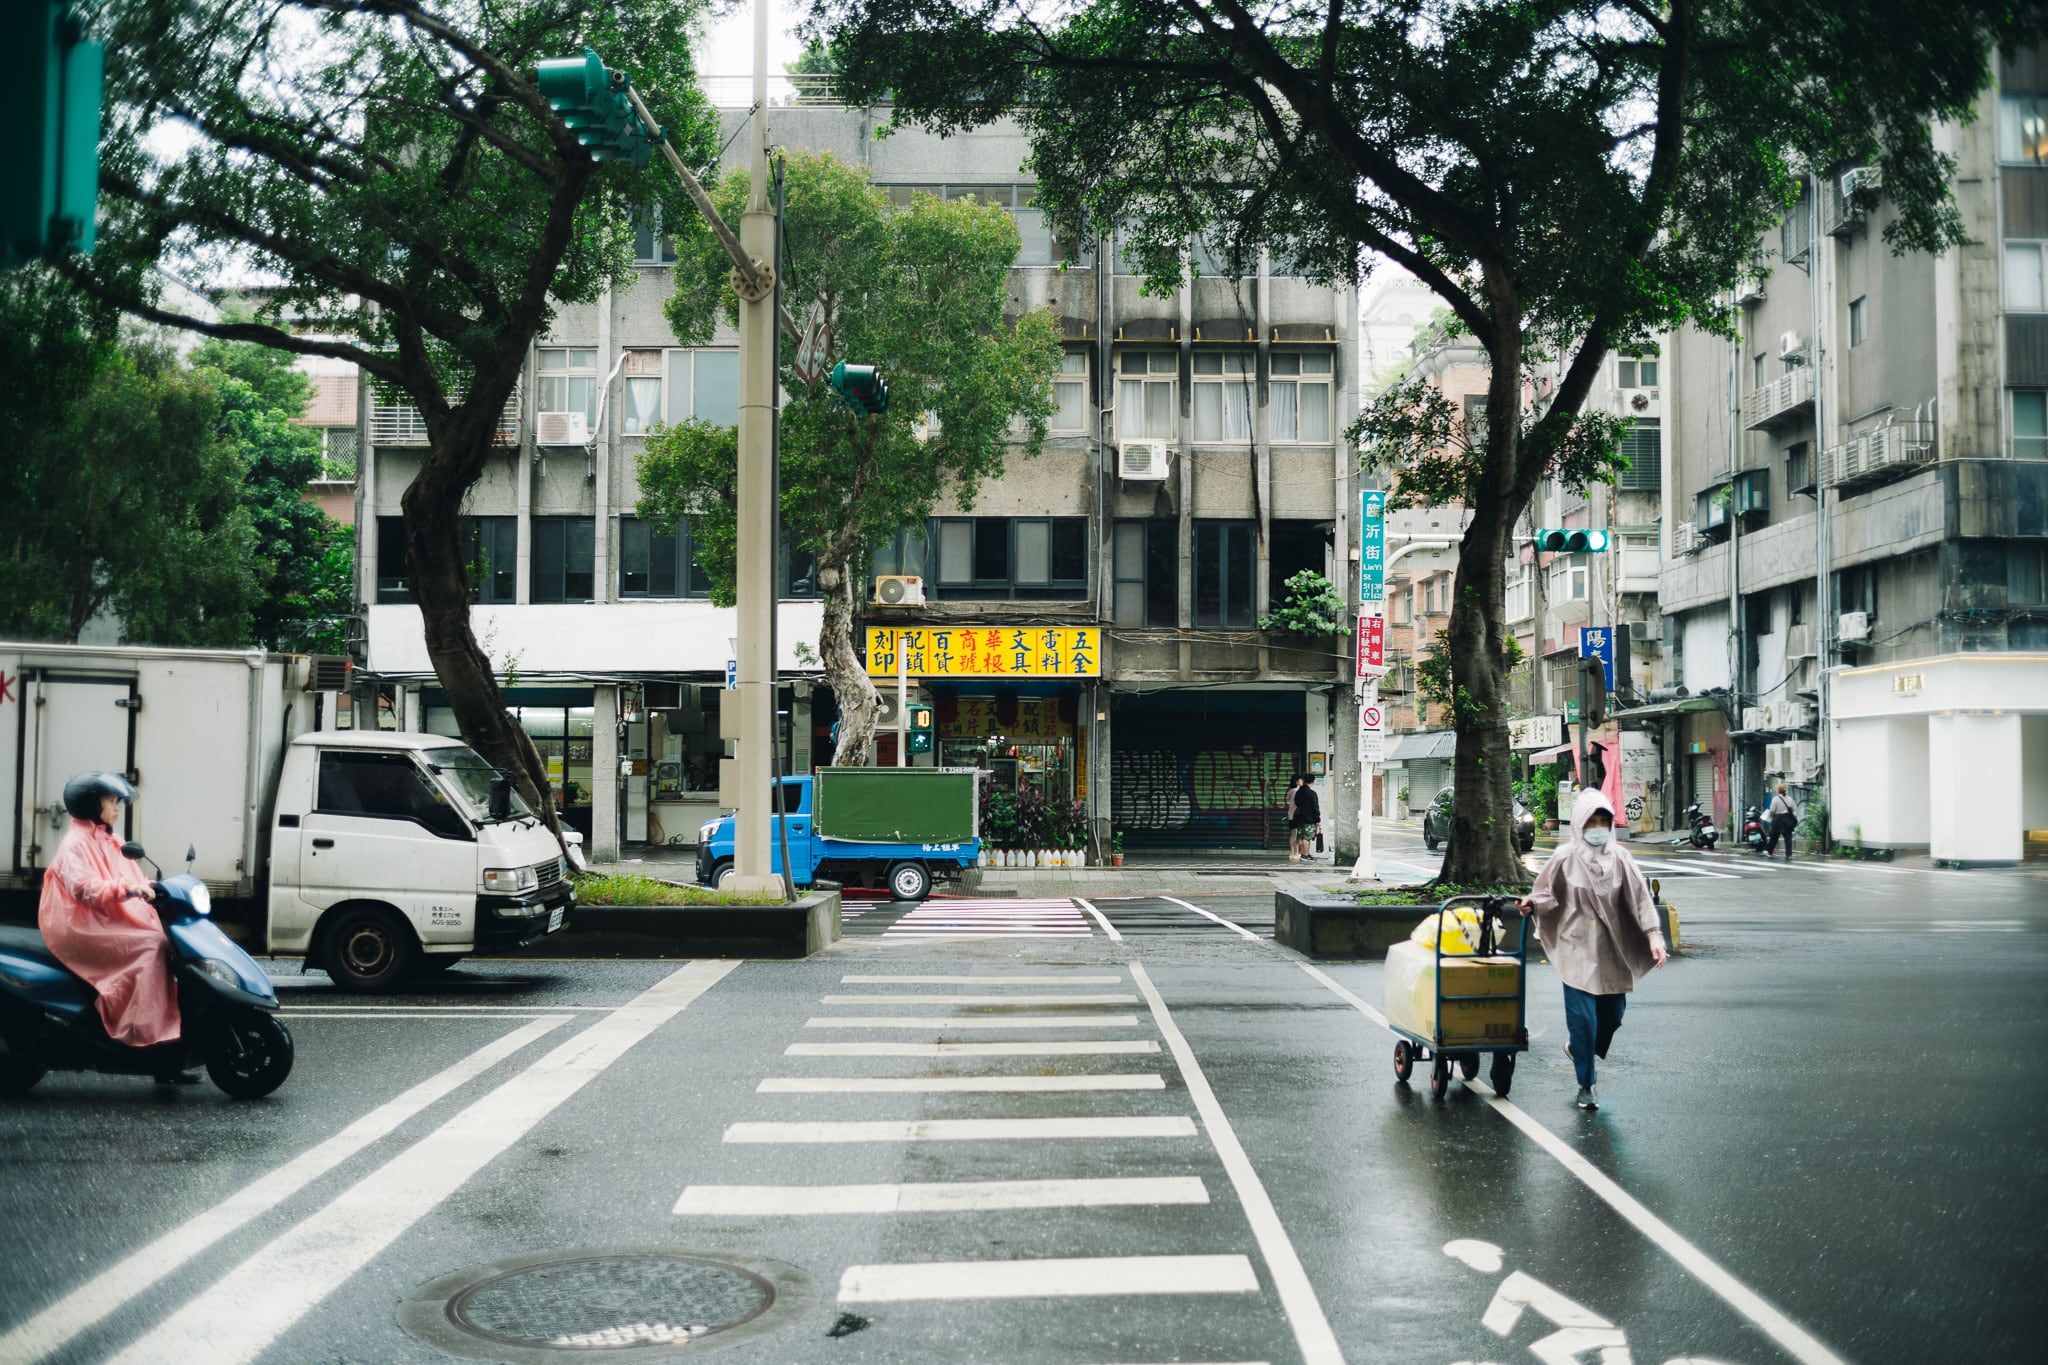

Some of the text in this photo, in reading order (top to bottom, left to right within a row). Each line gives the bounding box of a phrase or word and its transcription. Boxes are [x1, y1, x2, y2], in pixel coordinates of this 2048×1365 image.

[1365, 503, 1381, 560] 臨沂街
[1363, 563, 1383, 571] LinYi
[874, 630, 895, 673] 刻印
[899, 630, 926, 673] 配鎖
[932, 631, 954, 673] 百貨
[1010, 630, 1033, 673] 文具
[1041, 630, 1062, 673] 電料
[1070, 631, 1093, 673] 五金
[1371, 619, 1381, 661] 右轉車
[729, 661, 736, 671] P
[917, 710, 930, 728] 10
